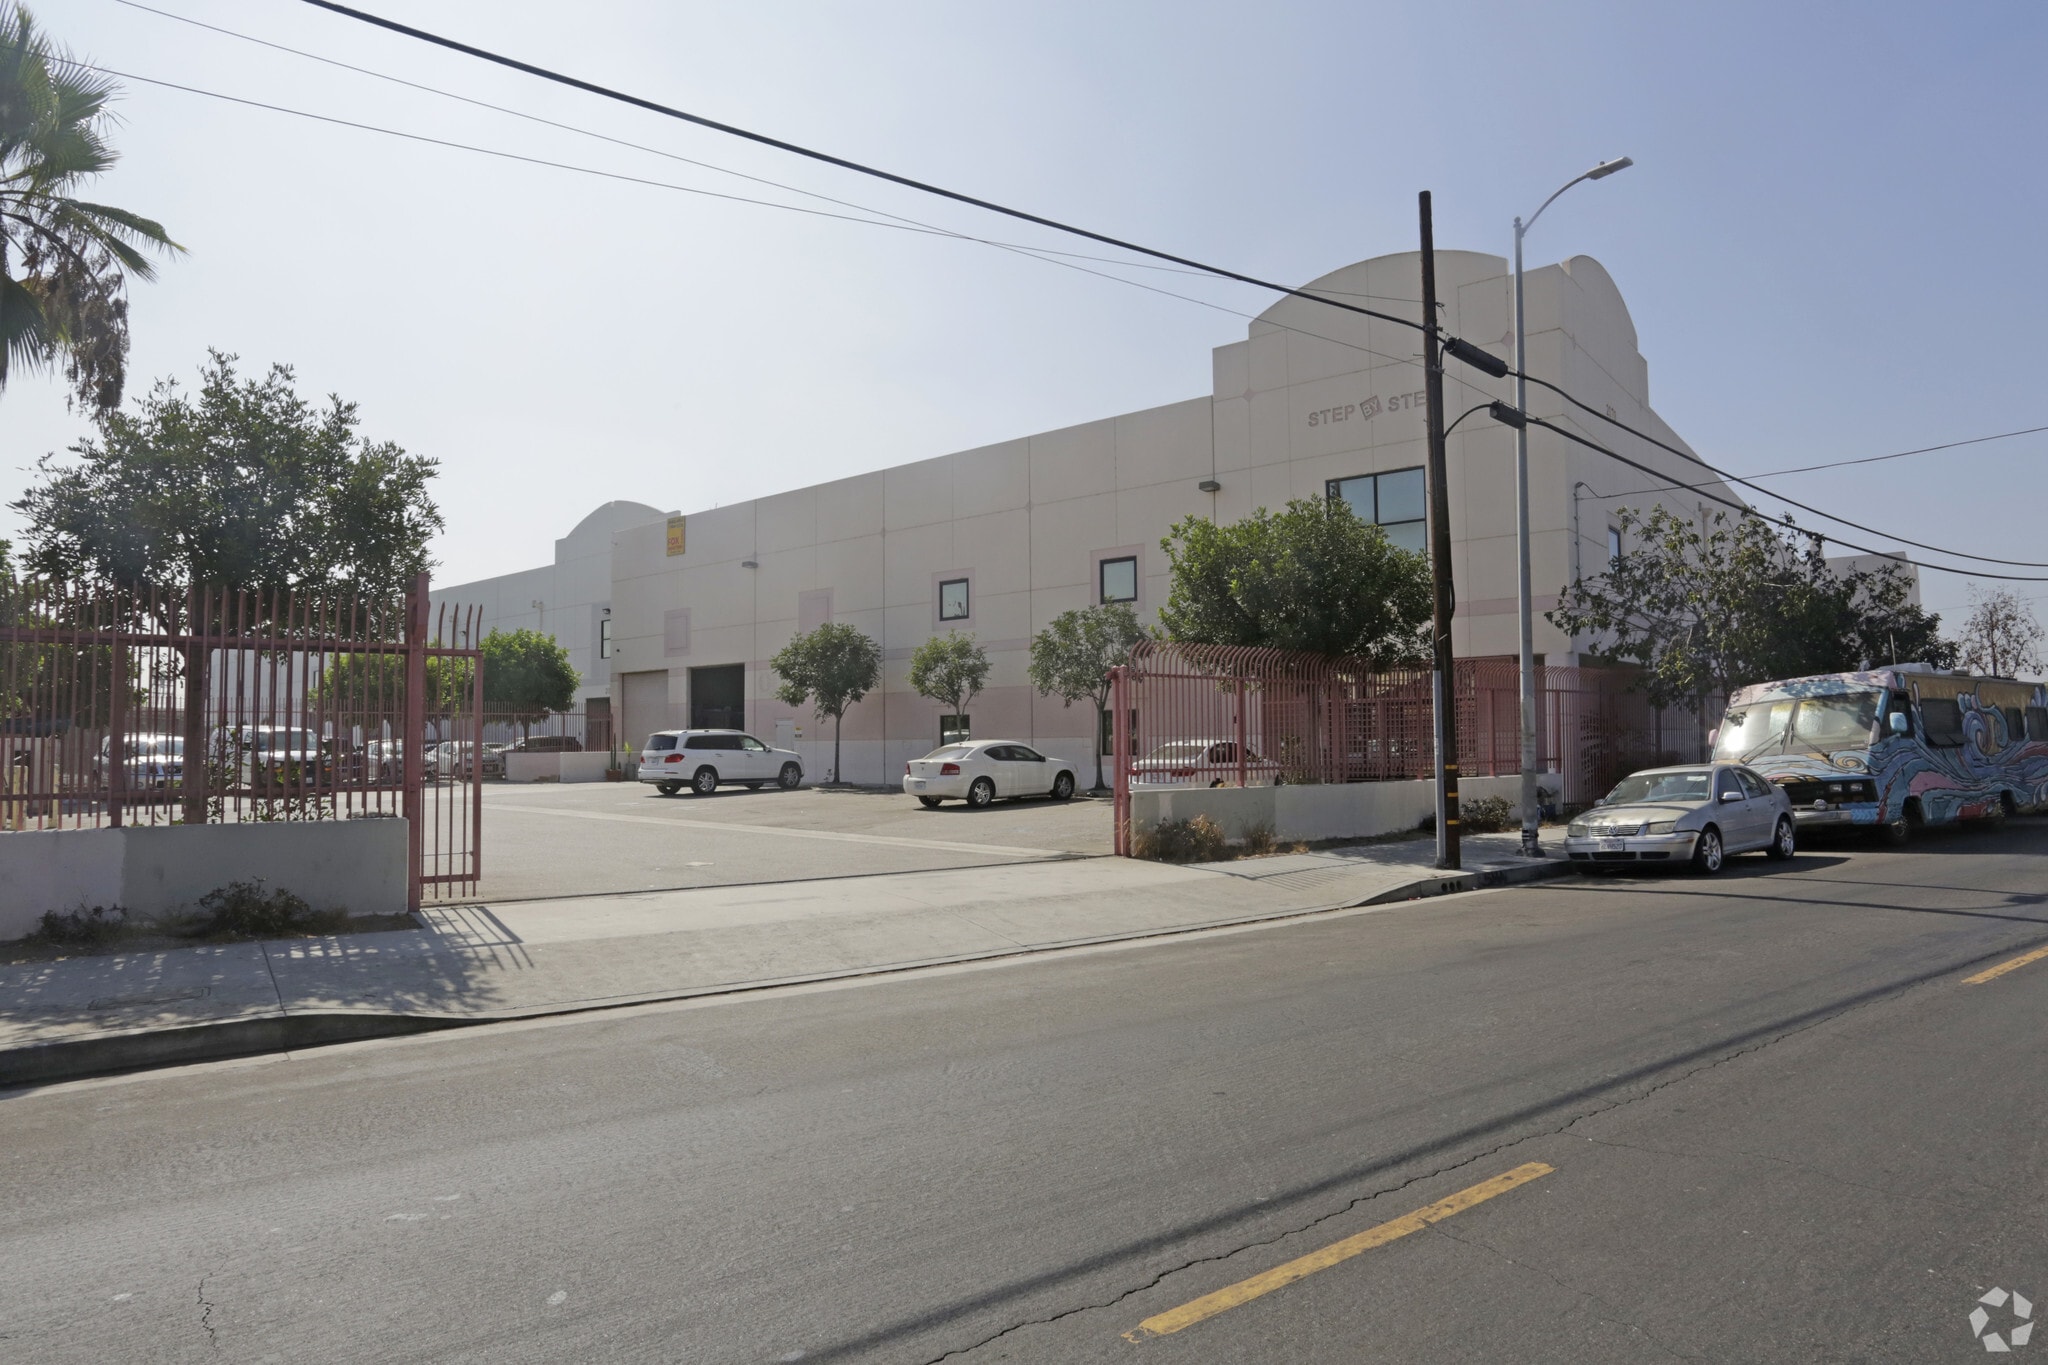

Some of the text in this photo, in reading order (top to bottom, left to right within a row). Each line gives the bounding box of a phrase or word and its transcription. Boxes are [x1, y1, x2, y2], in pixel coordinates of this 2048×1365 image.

[1308, 391, 1426, 427] STEP BY STE
